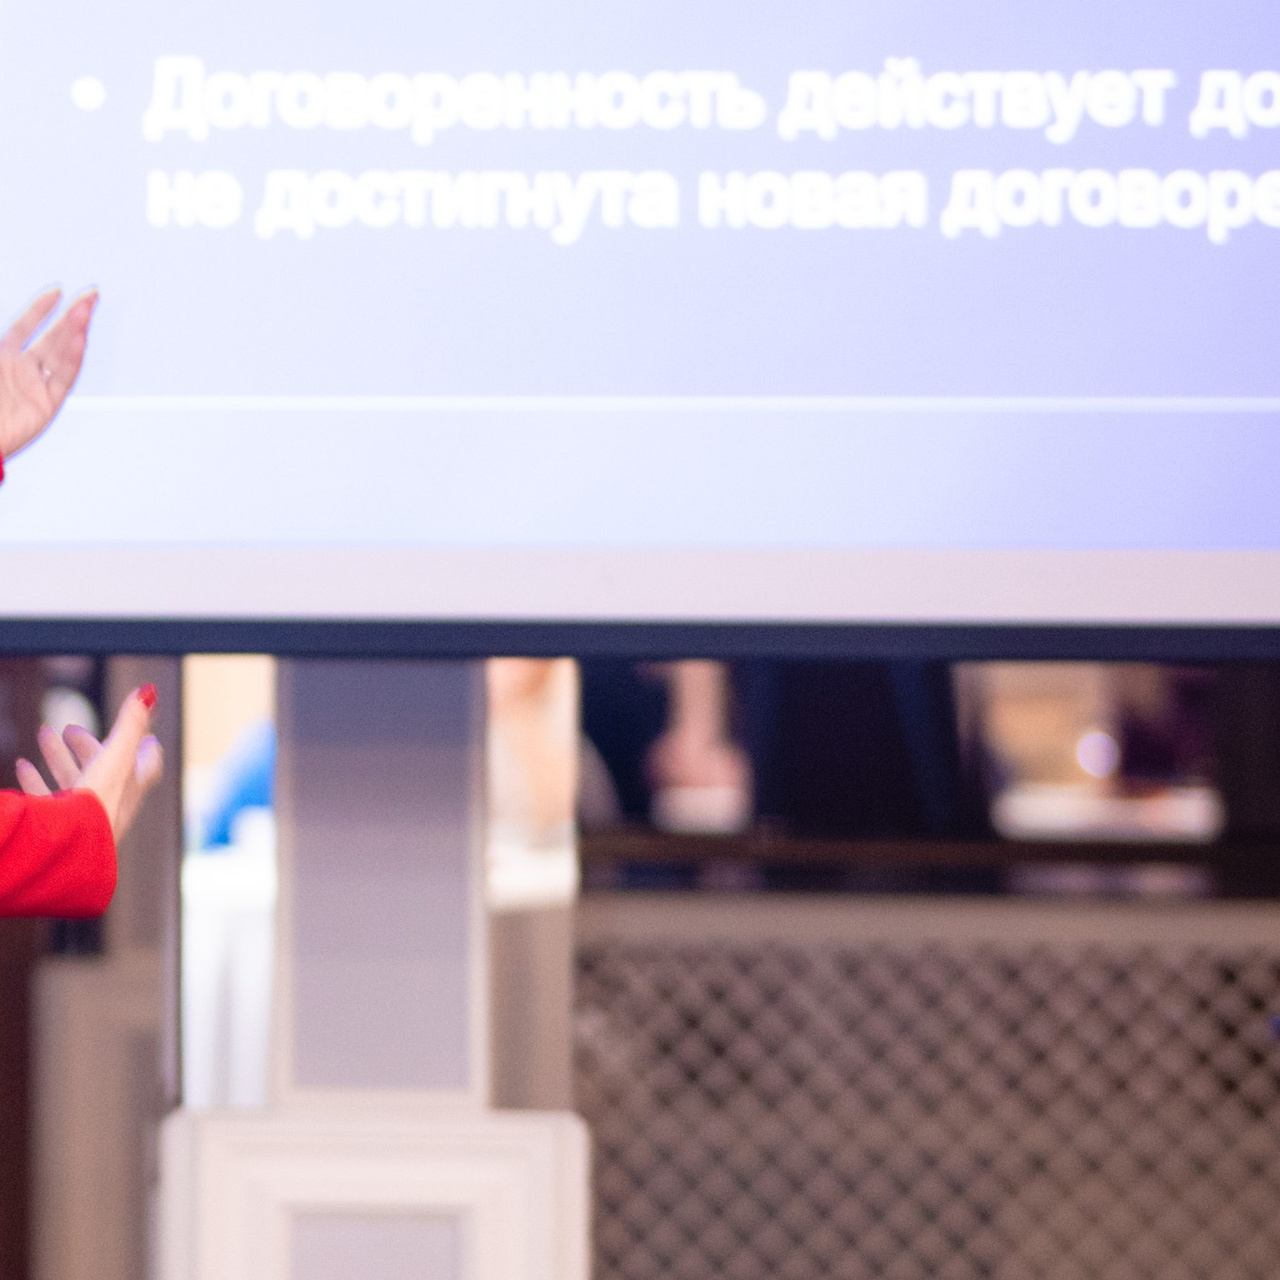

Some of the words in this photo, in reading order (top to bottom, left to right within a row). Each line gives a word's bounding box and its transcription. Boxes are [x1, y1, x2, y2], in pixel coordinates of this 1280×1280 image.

[142, 55, 767, 146] Договоренность
[776, 57, 1175, 144] действует
[1188, 69, 1280, 137] до
[146, 169, 243, 228] не
[254, 169, 680, 246] достигнута
[697, 169, 928, 230] новая
